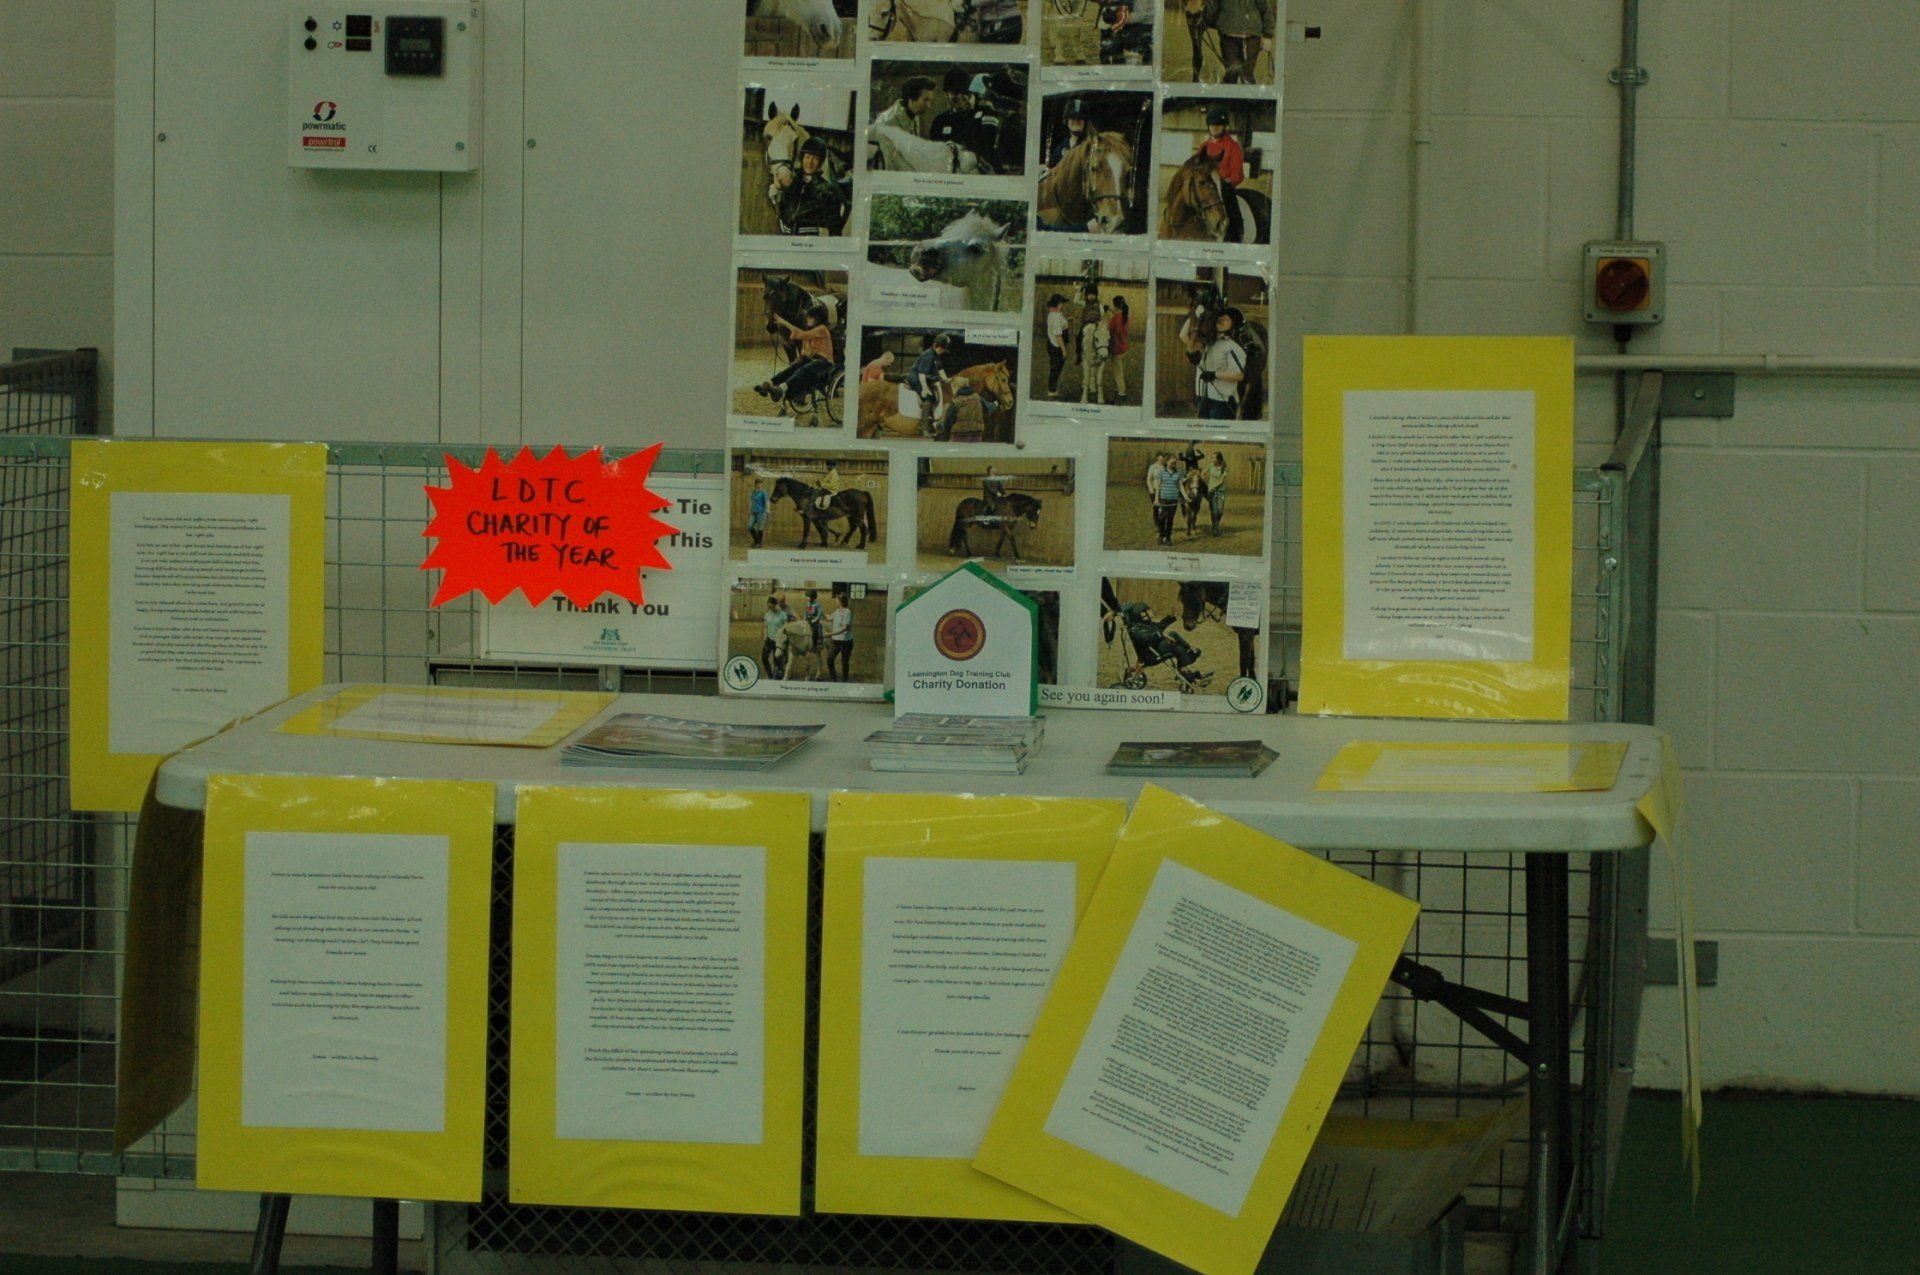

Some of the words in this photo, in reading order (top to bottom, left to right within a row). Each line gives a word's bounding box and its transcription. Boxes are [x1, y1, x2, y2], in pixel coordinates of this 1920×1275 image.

[302, 122, 346, 131] powrmatic
[677, 499, 711, 515] Tie
[467, 511, 571, 541] CHARITY
[583, 516, 610, 538] OF
[670, 532, 713, 549] This
[500, 541, 540, 563] THE
[552, 543, 619, 570] YEAR
[628, 599, 669, 616] You
[908, 670, 947, 678] Leamington
[950, 670, 964, 678] Dog
[966, 670, 994, 678] Training
[995, 670, 1011, 678] Club
[913, 680, 952, 691] Charity
[956, 680, 1006, 690] Donation
[1041, 688, 1063, 701] See
[1067, 691, 1090, 704] you
[1094, 690, 1127, 705] again
[1131, 692, 1164, 704] soon!
